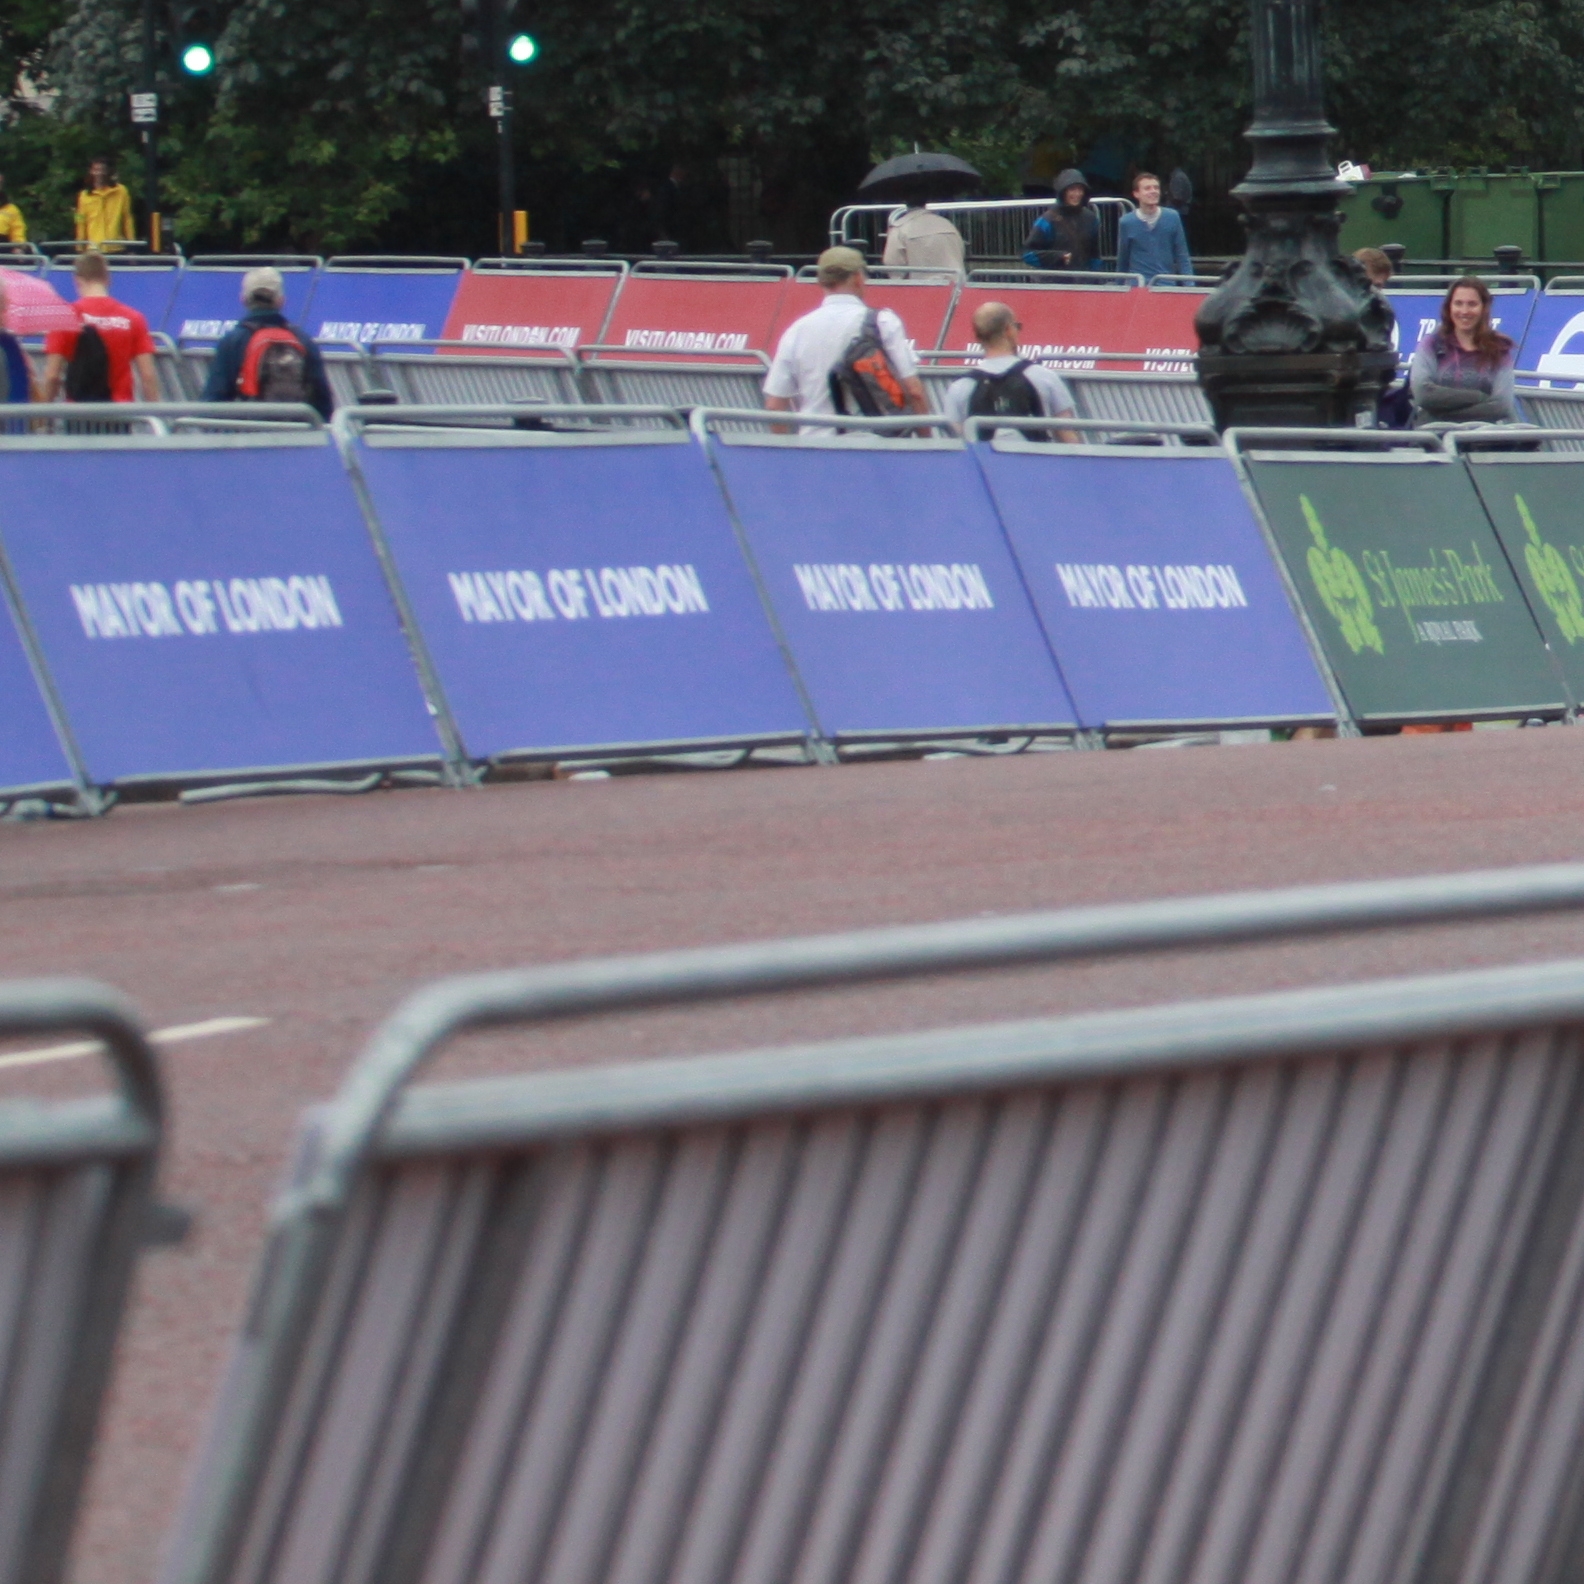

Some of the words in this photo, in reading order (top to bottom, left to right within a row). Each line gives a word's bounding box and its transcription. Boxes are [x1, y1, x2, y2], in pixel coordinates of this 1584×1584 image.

[462, 323, 581, 348] VISITLONDONCOM
[624, 328, 749, 350] VISITLONDONCOM
[447, 570, 556, 623] MAYOR
[546, 568, 590, 620] OF
[584, 564, 710, 618] LONDON
[793, 563, 879, 611] MAYOR
[868, 563, 905, 611] OF
[896, 563, 994, 611] LONDON
[1055, 563, 1136, 609] MAYOR
[1125, 564, 1160, 610] OF
[1151, 564, 1248, 610] LONDON
[1442, 540, 1504, 605] Park
[70, 581, 183, 639] MAYOR
[174, 579, 219, 635] OF
[212, 574, 343, 634] LONDON
